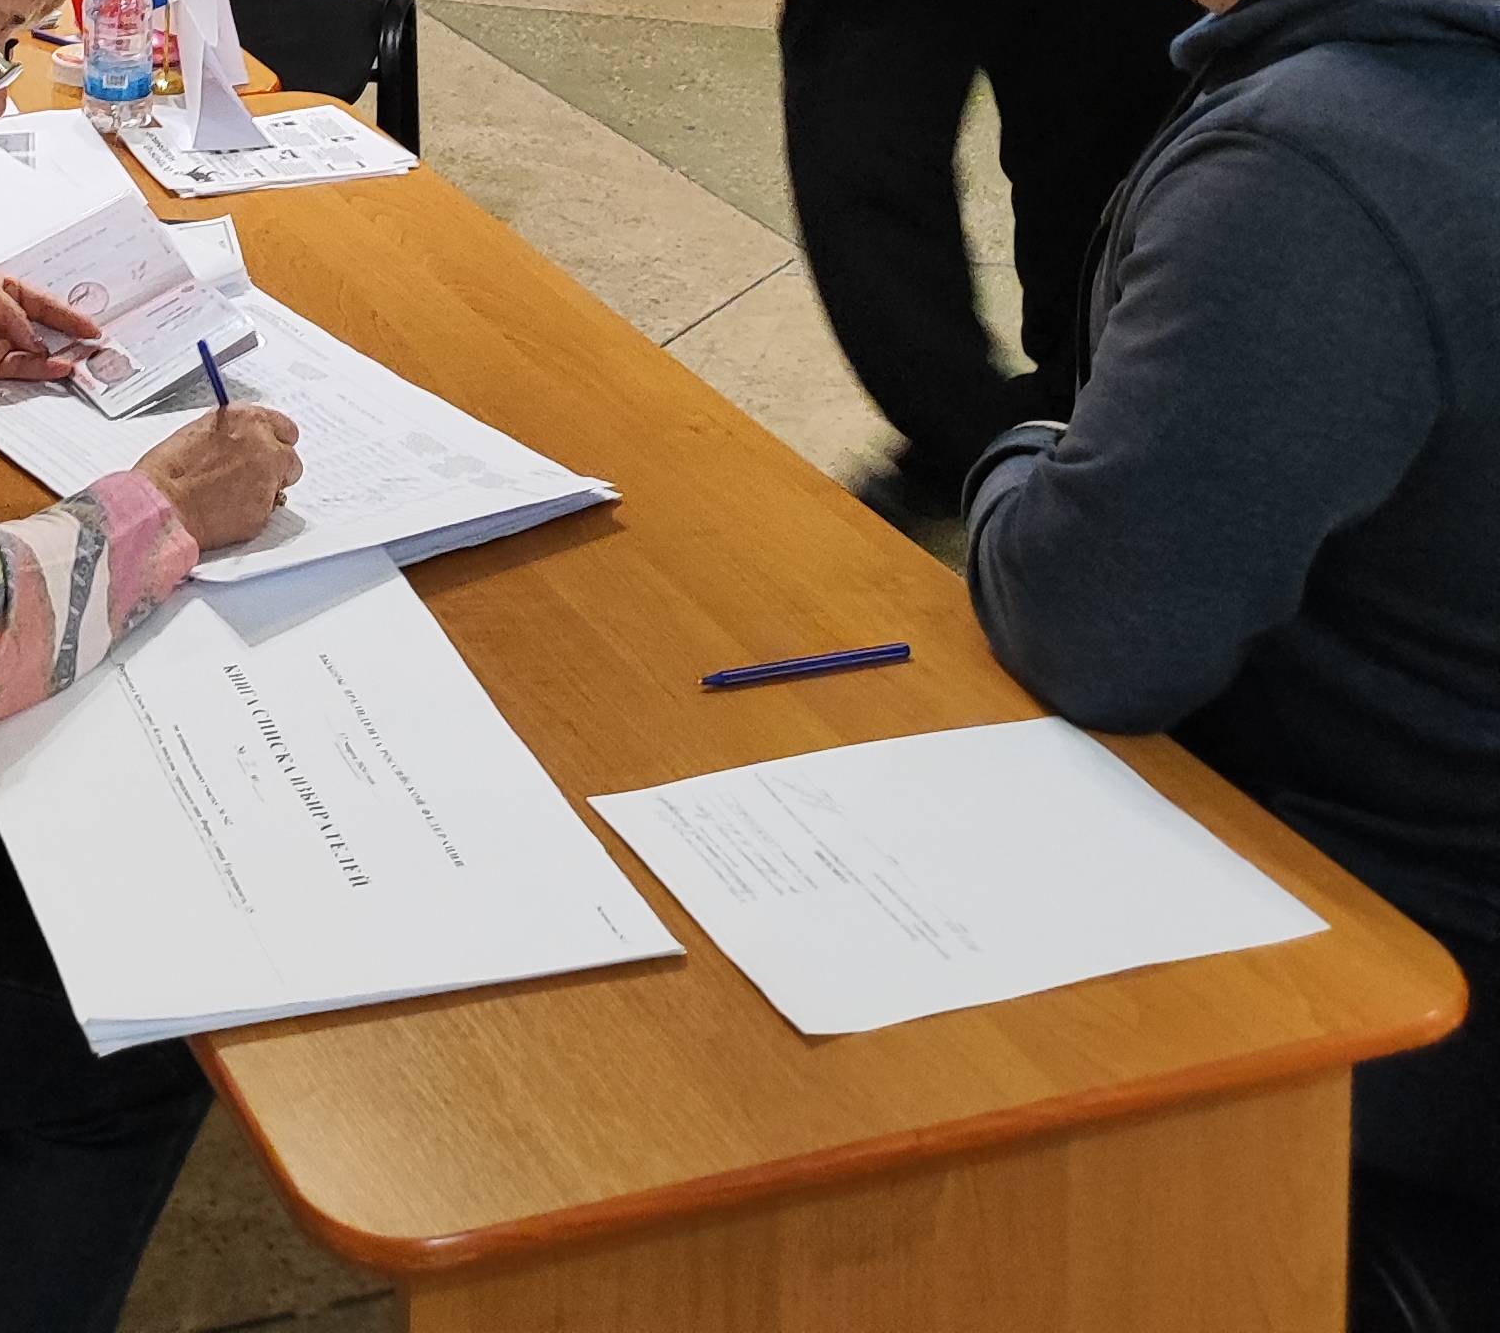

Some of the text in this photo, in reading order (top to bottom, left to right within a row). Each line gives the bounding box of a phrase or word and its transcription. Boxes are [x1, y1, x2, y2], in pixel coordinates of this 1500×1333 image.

[223, 664, 259, 706] КНИГА
[252, 709, 296, 774] СПИСКА
[290, 776, 371, 888] ИЗБИРАТЕЛЕЙ
